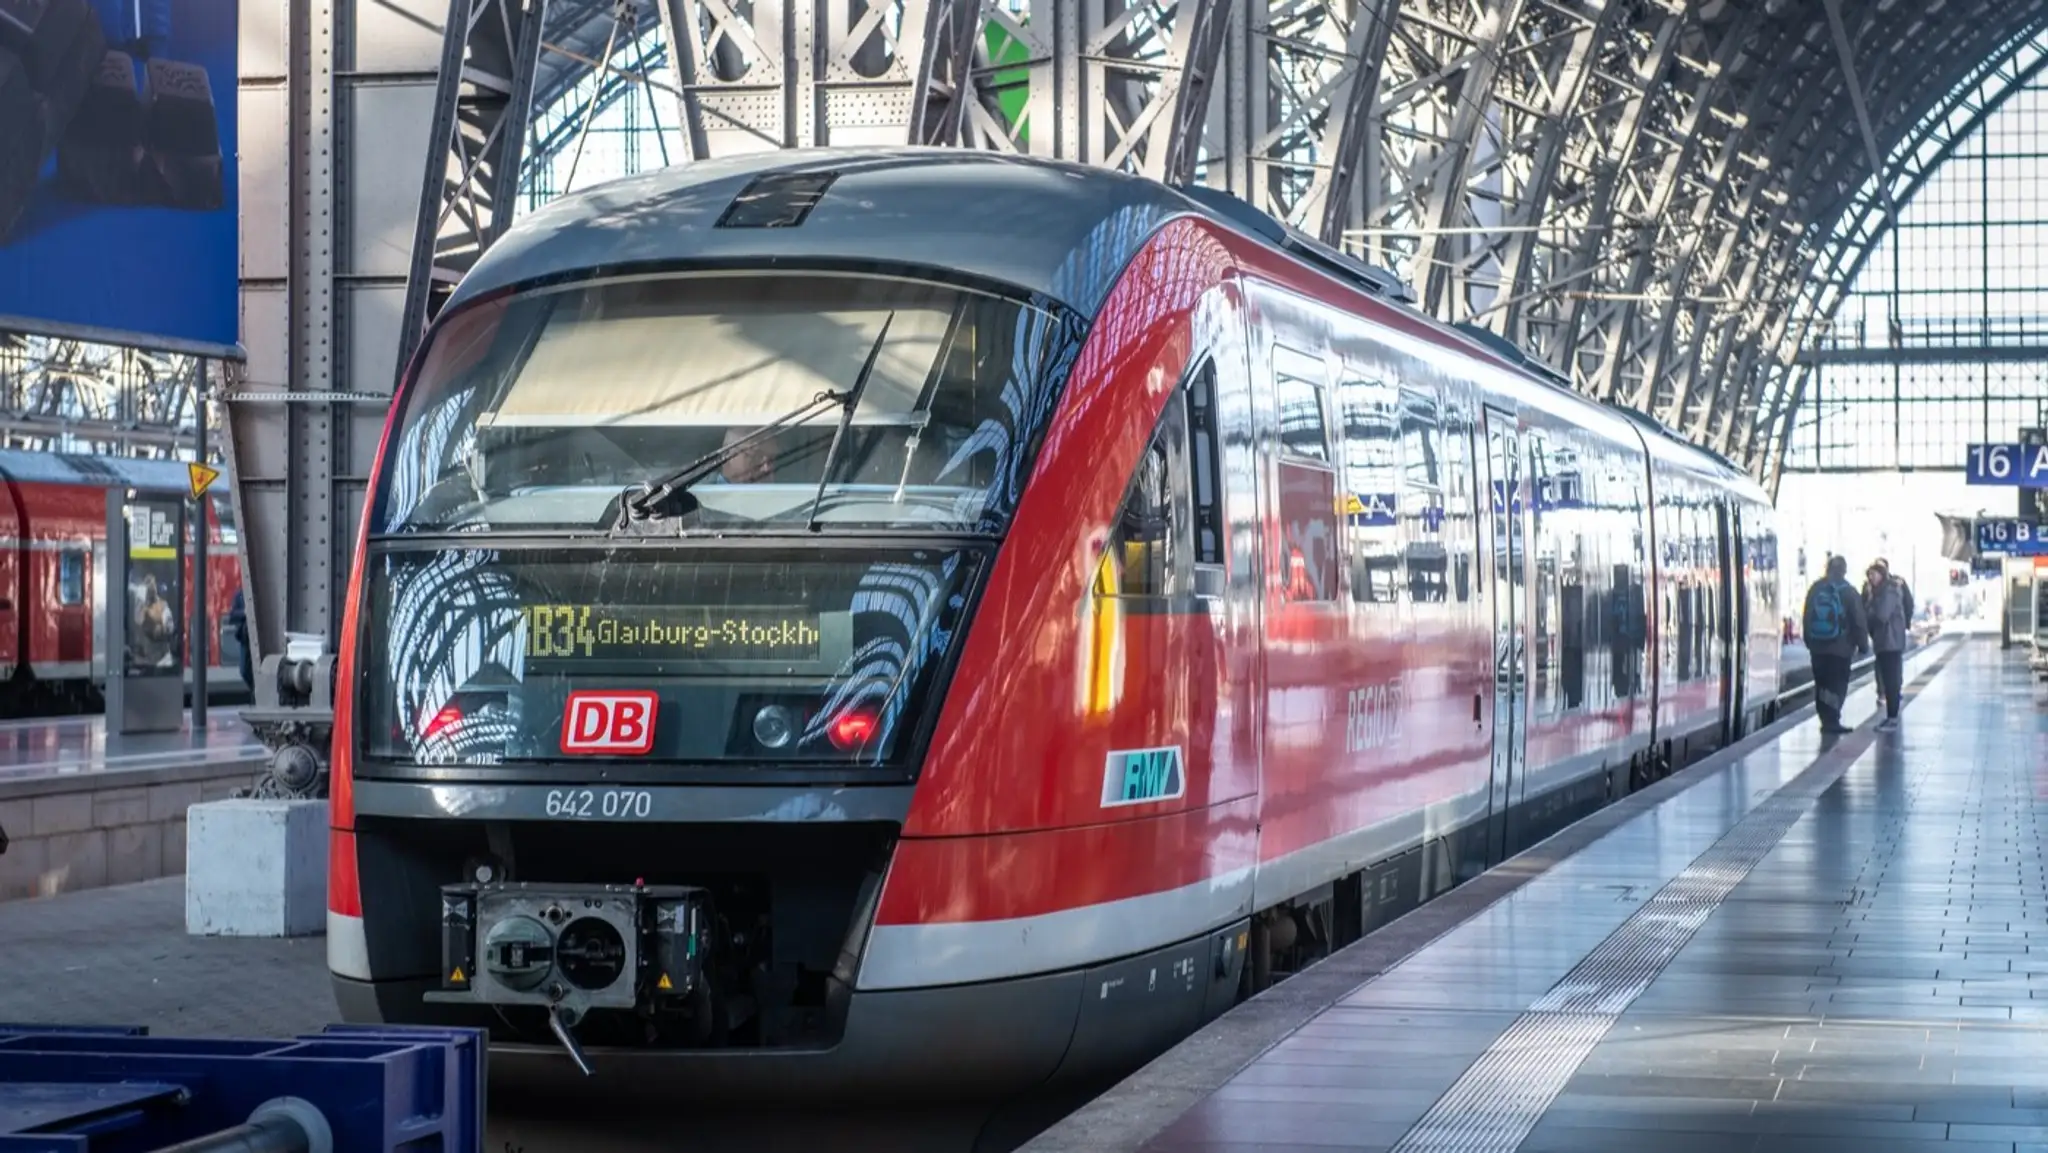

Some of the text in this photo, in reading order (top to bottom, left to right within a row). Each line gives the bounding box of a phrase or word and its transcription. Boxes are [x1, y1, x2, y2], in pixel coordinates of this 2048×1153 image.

[1971, 445, 2010, 477] 16
[1986, 522, 2007, 541] 16
[2016, 522, 2030, 541] B
[573, 701, 645, 742] DB
[1346, 684, 1386, 754] REGIO
[546, 789, 652, 817] 642 070
